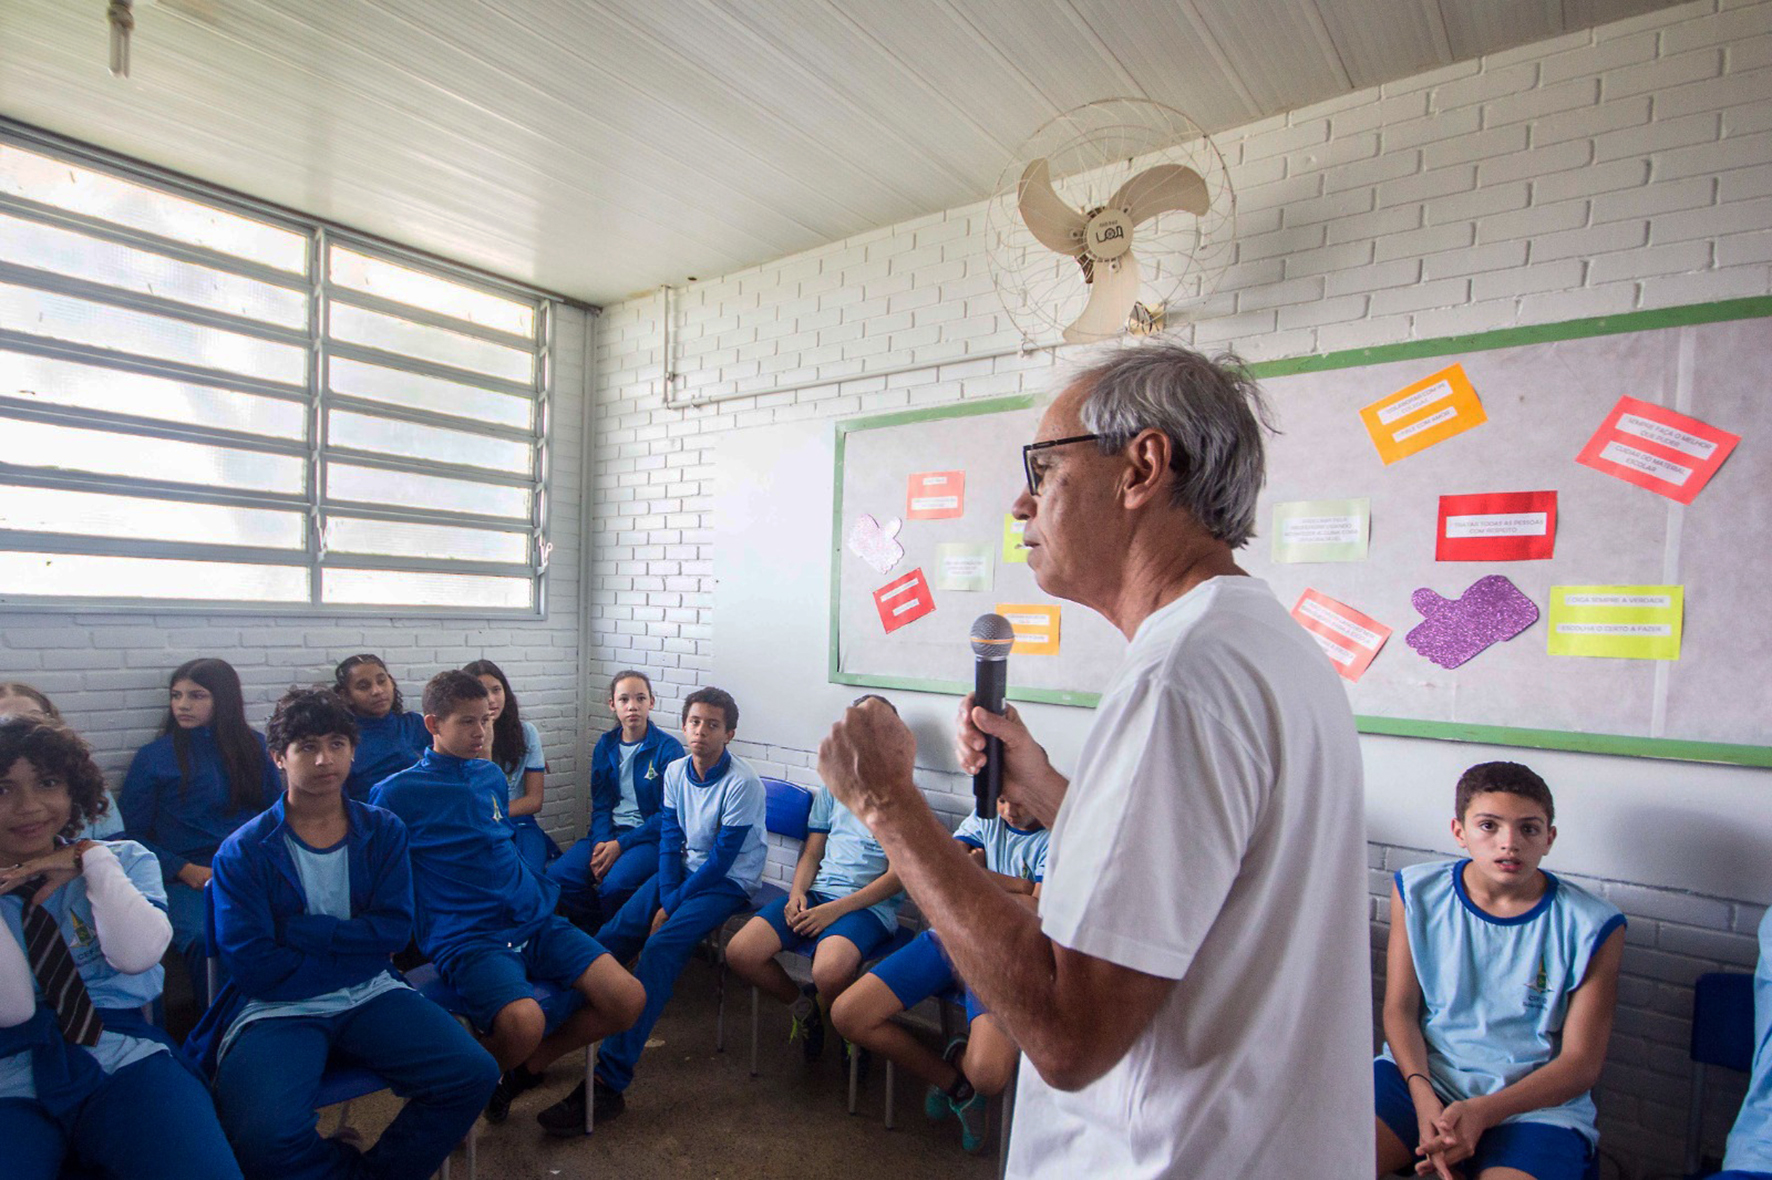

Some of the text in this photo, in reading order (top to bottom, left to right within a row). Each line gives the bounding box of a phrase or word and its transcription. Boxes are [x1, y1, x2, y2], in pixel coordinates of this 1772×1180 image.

[1681, 434, 1712, 450] MELHOR
[1625, 457, 1657, 472] ESCOLAR
[1653, 458, 1686, 475] MATERIAL
[1486, 526, 1518, 534] RESPEITO
